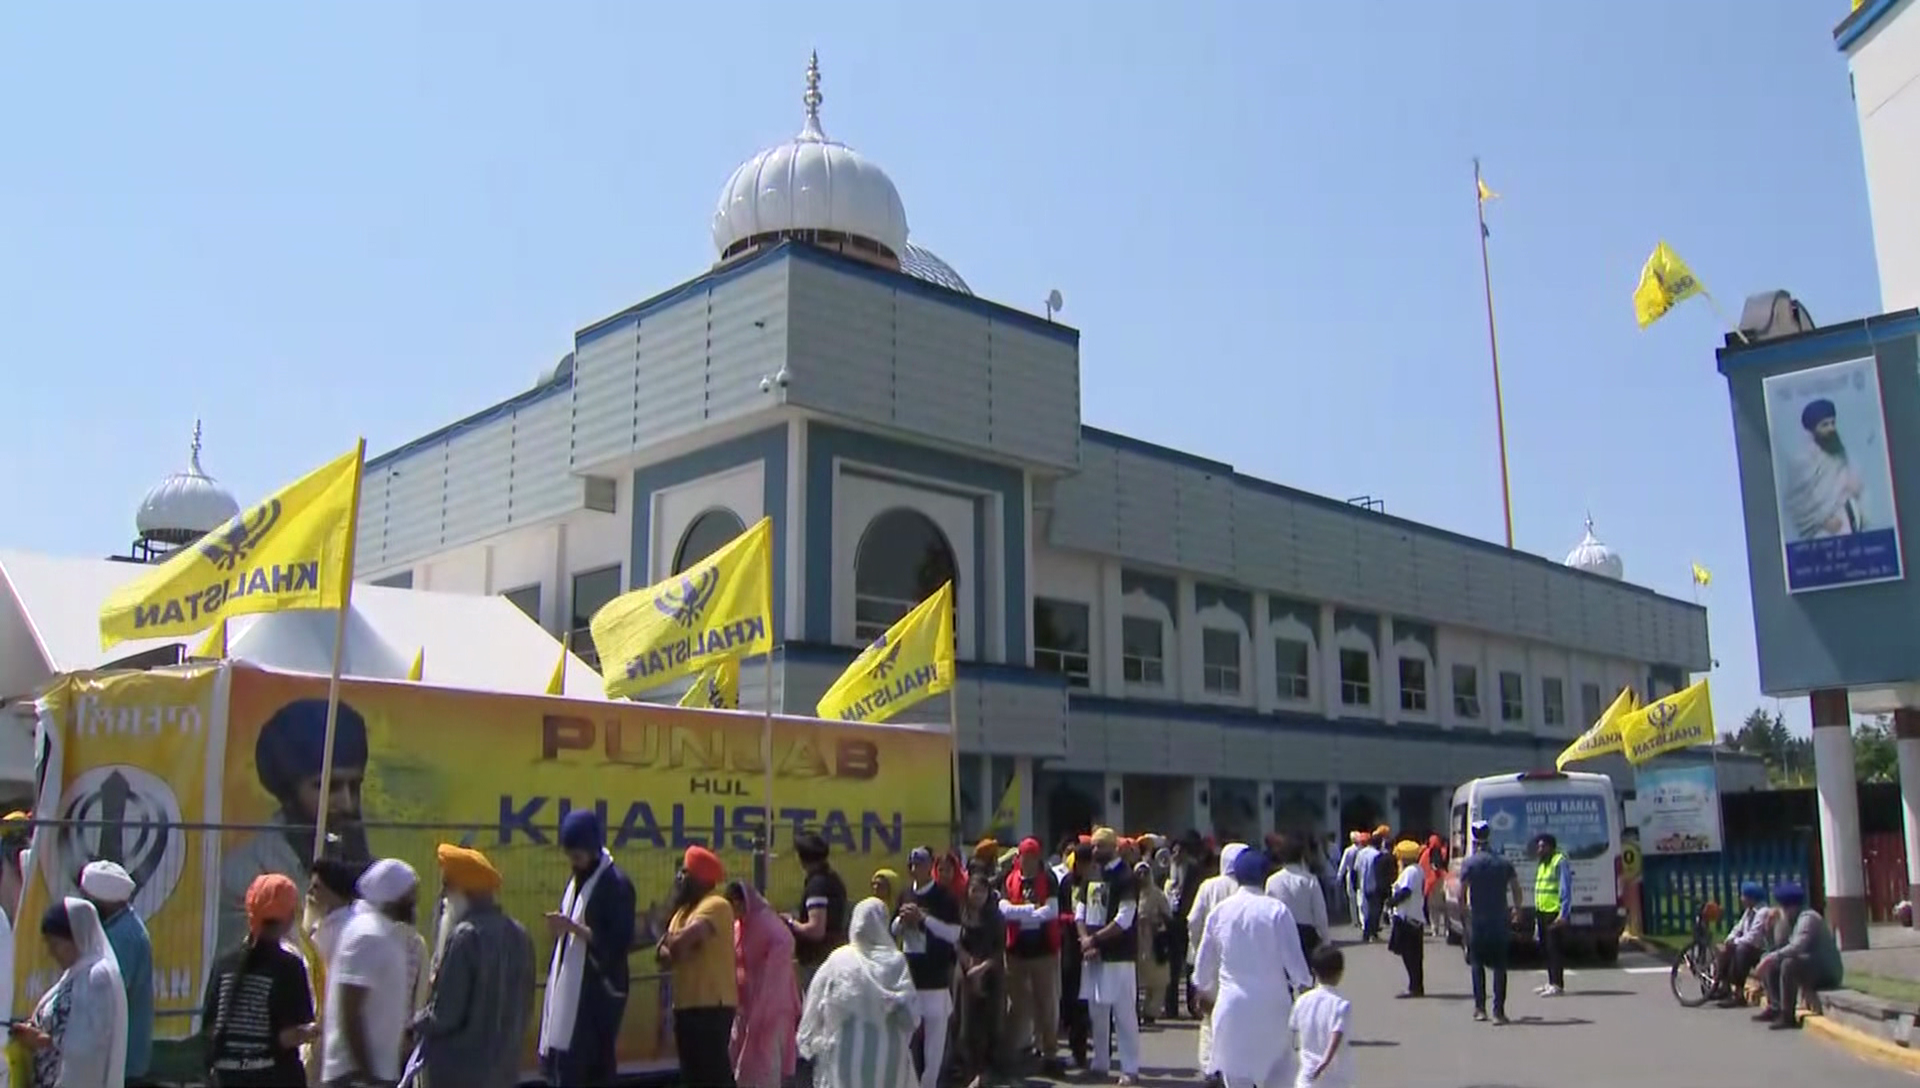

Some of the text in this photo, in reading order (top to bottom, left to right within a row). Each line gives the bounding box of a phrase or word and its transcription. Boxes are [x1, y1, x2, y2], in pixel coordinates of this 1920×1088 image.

[543, 714, 878, 779] PUNJAB
[690, 777, 750, 797] HUL
[499, 795, 901, 854] KHALISTAN
[1526, 800, 1599, 814] GURU NANAK
